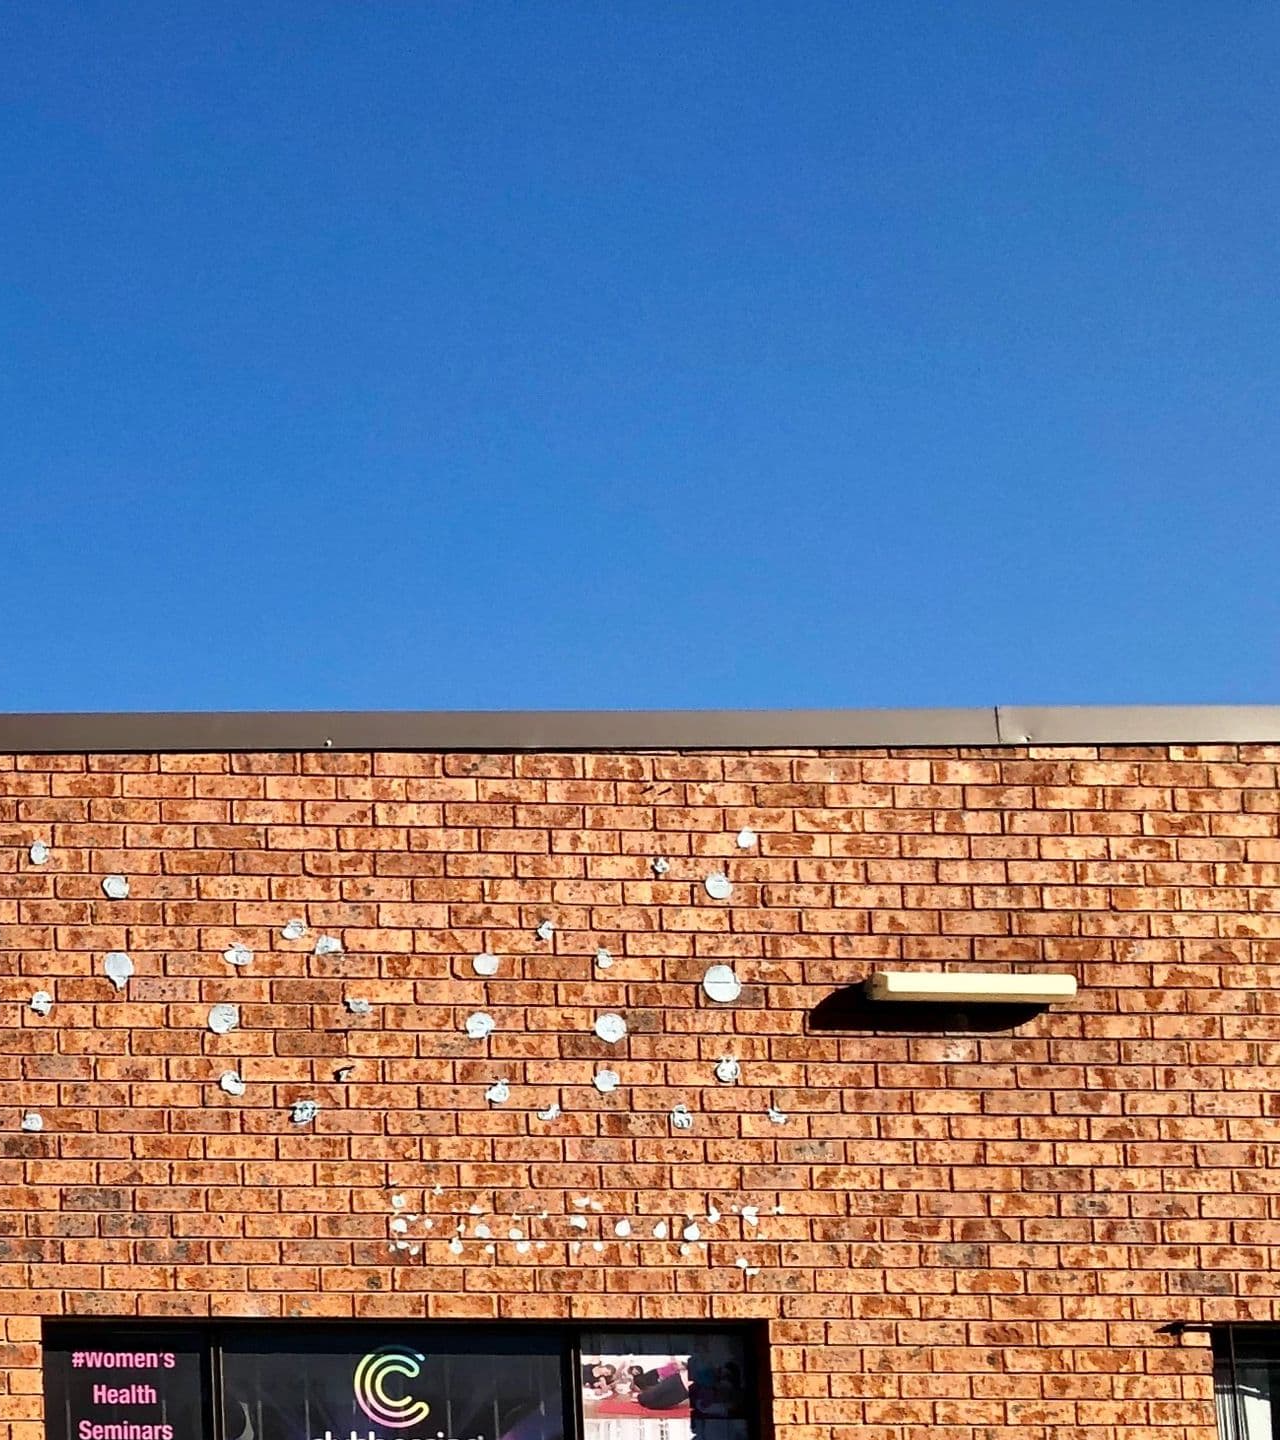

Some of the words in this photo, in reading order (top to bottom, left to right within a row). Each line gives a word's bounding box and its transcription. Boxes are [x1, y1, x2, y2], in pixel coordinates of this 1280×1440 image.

[71, 1350, 176, 1368] #Women's
[92, 1384, 158, 1404] Health
[78, 1419, 174, 1440] Seminars
